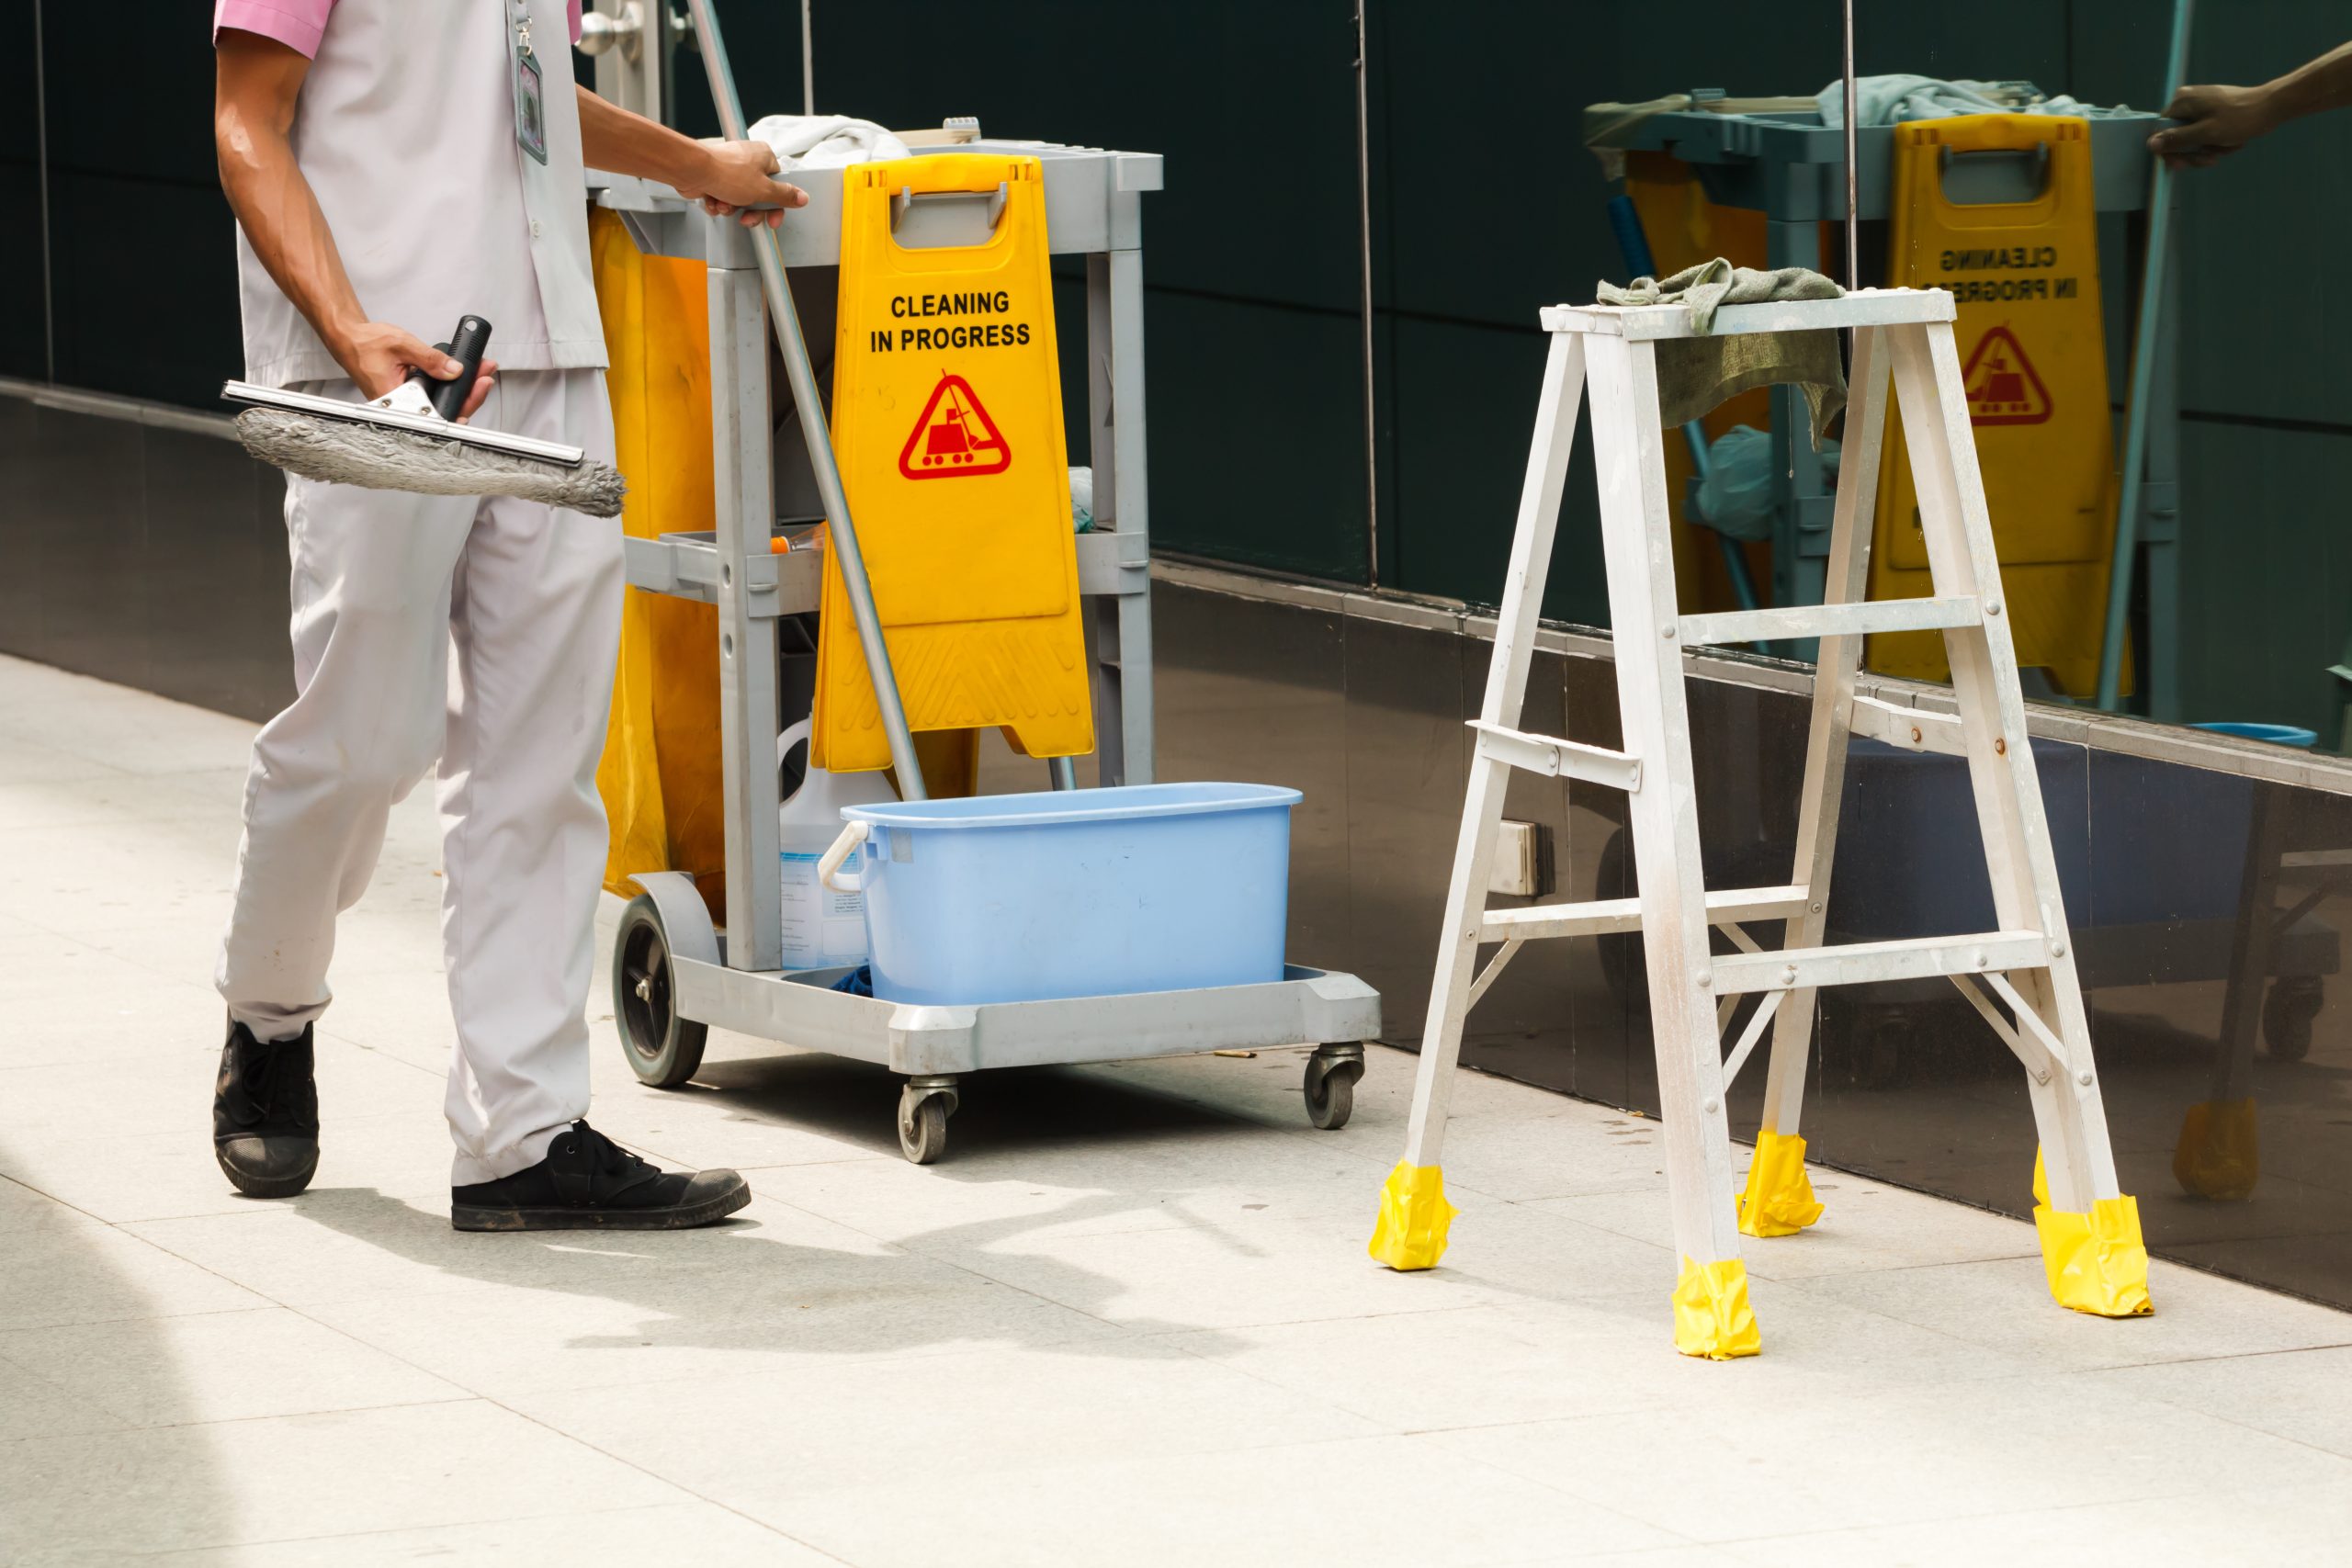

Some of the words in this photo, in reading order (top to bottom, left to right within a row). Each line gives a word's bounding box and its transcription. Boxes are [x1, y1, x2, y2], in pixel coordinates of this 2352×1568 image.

[891, 291, 1010, 318] CLEANING
[871, 331, 892, 353] IN
[901, 323, 1030, 351] PROGRESS
